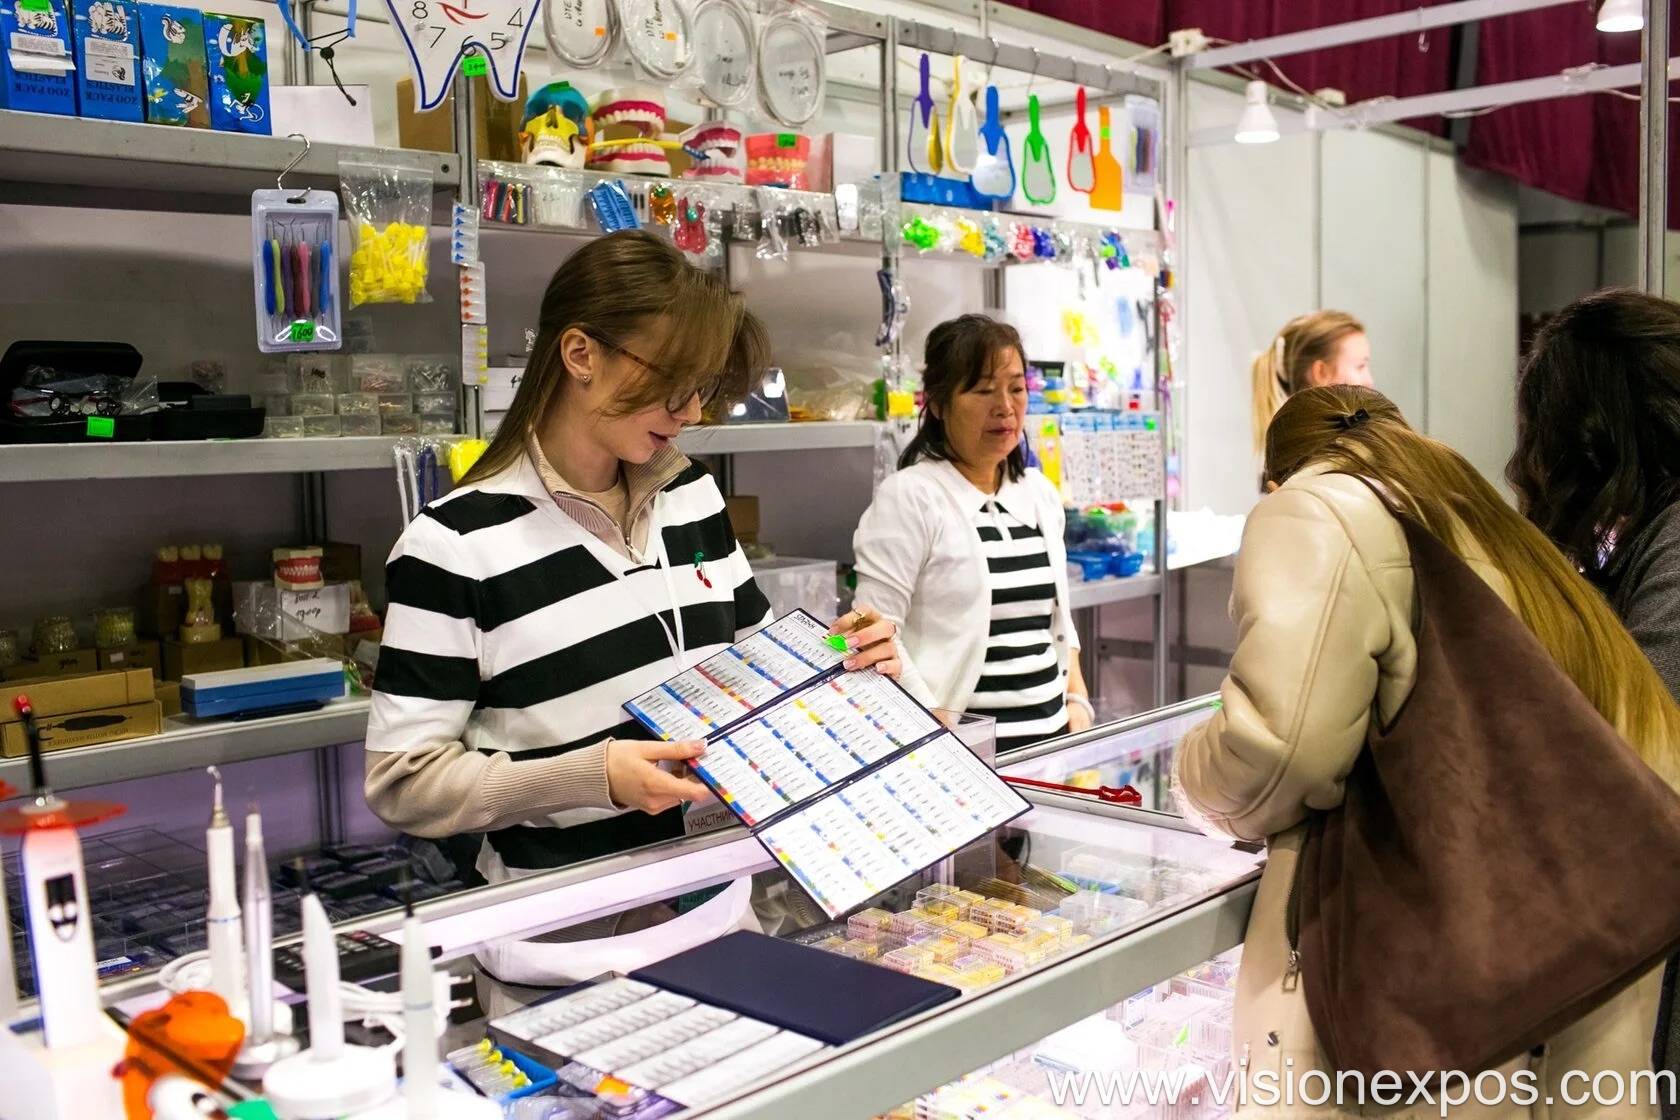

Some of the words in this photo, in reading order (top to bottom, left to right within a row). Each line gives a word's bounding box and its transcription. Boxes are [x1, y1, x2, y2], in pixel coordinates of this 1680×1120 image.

[412, 1, 428, 19] 8
[507, 7, 523, 28] 4
[430, 26, 446, 48] 7
[461, 35, 476, 56] 6
[491, 32, 506, 50] 5
